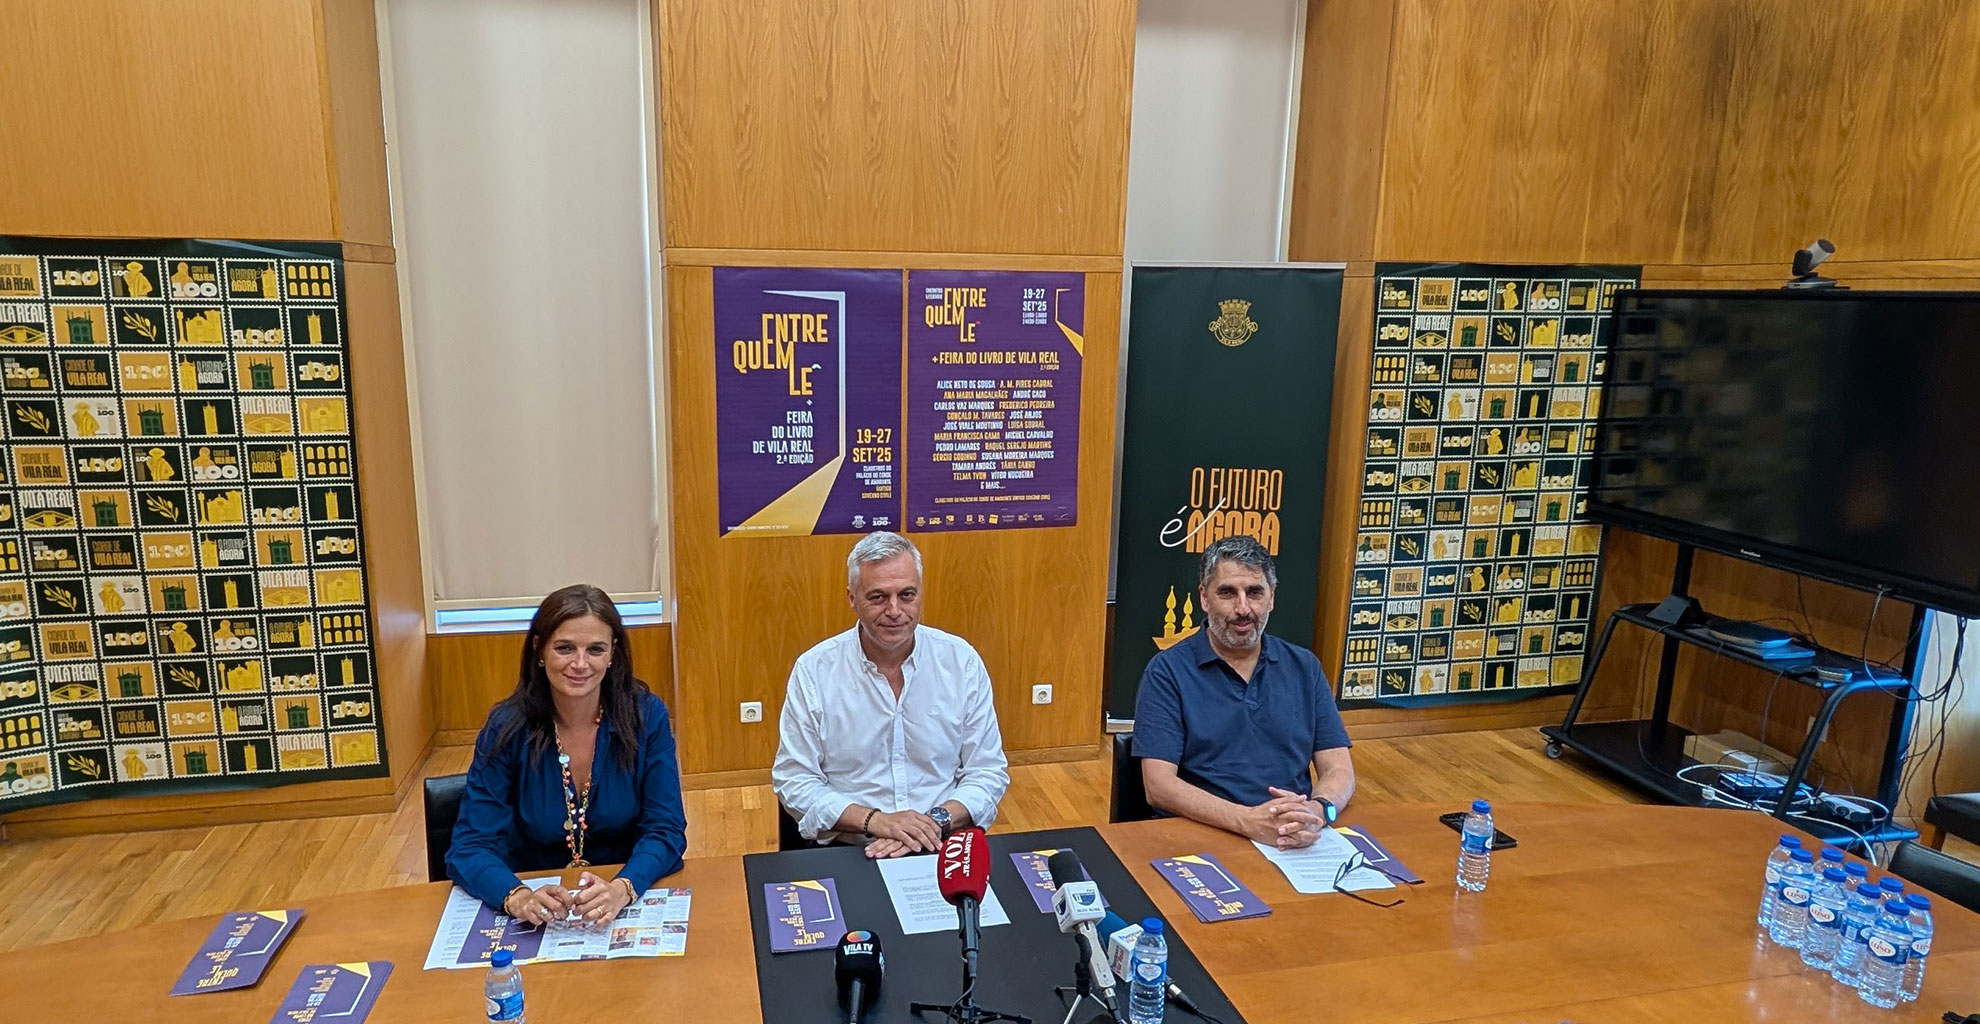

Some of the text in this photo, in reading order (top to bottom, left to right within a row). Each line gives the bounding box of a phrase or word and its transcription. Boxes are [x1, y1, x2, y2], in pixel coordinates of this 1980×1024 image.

[171, 282, 218, 298] 100
[231, 280, 258, 292] AGORA
[944, 287, 987, 308] ENTRE
[1023, 288, 1045, 299] 19-27
[1530, 298, 1560, 310] 100
[925, 305, 964, 328] QUEM
[761, 313, 829, 343] ENTRE
[732, 339, 795, 374] QUEM
[939, 351, 964, 364] FEIRA
[966, 351, 978, 364] DO
[979, 351, 1003, 364] LIVRO
[1005, 351, 1016, 364] DE
[1018, 351, 1037, 364] VILA
[1038, 351, 1060, 364] REAL
[67, 372, 108, 386] VILA REAL
[198, 372, 224, 384] AGORA
[787, 411, 814, 424] FEIRA
[1371, 408, 1401, 420] 100
[772, 425, 814, 439] DO LIVRO
[856, 428, 892, 444] 19-27
[752, 440, 814, 454] DE VILA REAL
[1514, 442, 1541, 454] 100
[852, 447, 892, 463] SET'25
[22, 465, 63, 479] VILA REAL
[193, 465, 239, 480] 100
[1190, 467, 1283, 511] O FUTURO
[1160, 497, 1227, 548] é
[1186, 509, 1281, 556] AGORA
[94, 552, 133, 565] VILA REAL
[219, 549, 245, 560] AGORA
[1358, 550, 1387, 561] 100
[1496, 578, 1524, 590] 100
[49, 641, 88, 654] VILA REAL
[215, 636, 258, 651] 100
[1345, 685, 1374, 697] 100
[118, 720, 156, 734] VILA REAL
[944, 832, 966, 875] VOZ
[843, 943, 874, 956] VILA TV
